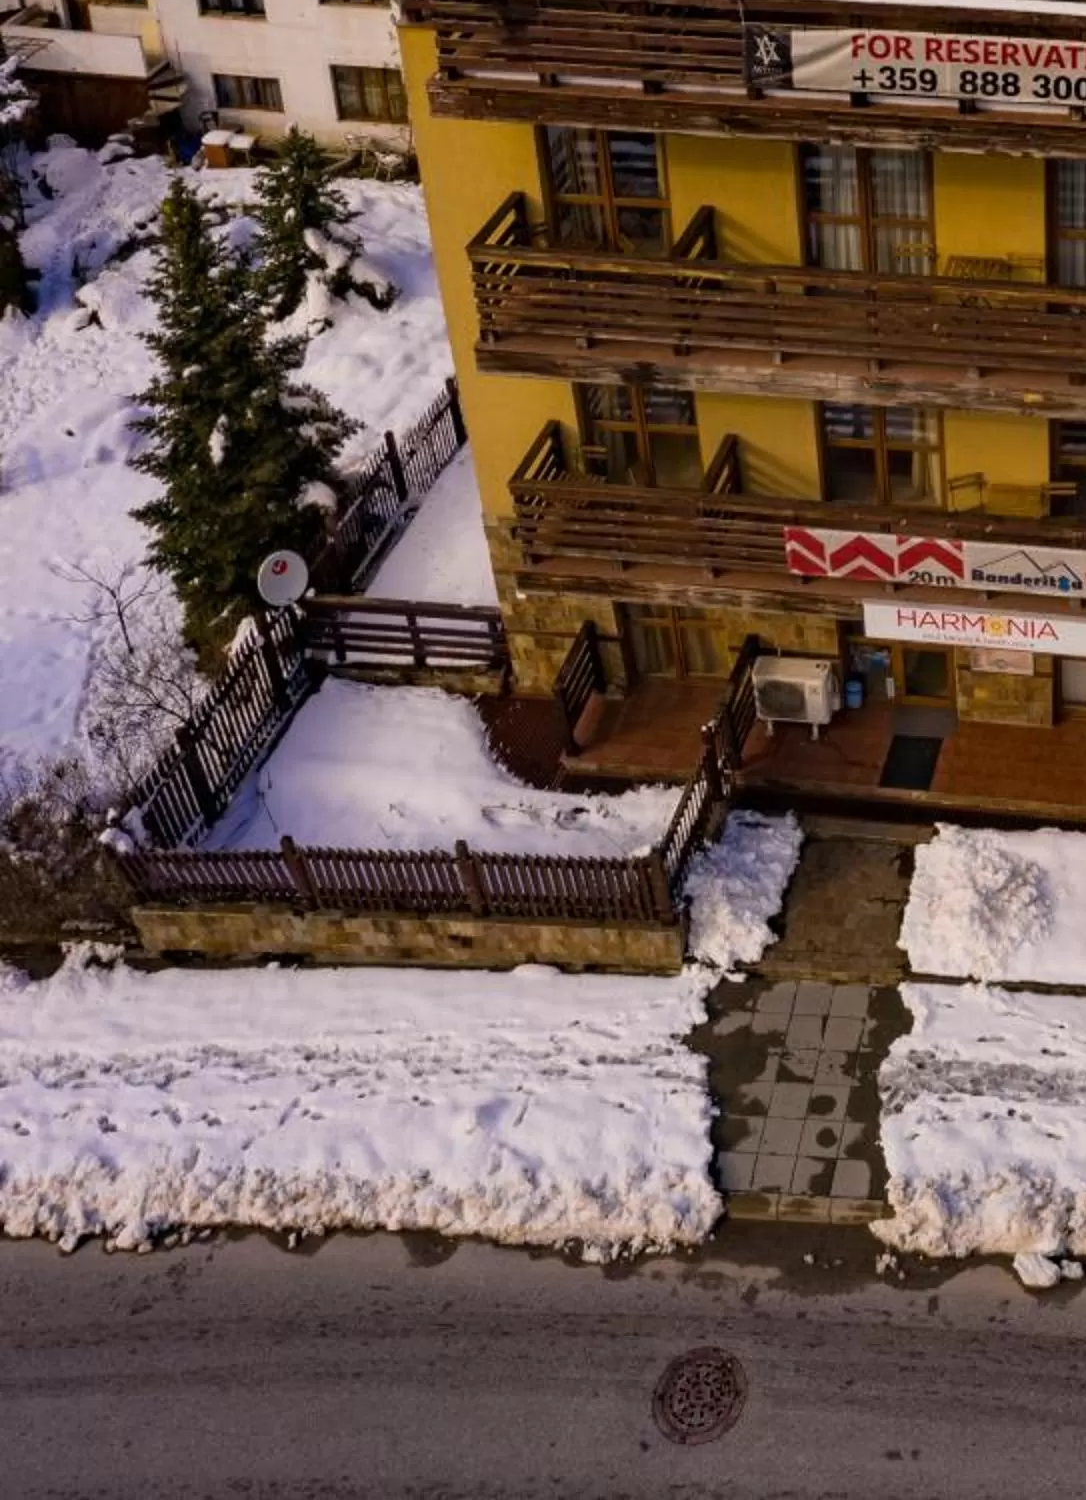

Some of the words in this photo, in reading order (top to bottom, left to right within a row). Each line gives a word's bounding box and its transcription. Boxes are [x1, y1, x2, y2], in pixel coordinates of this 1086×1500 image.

[851, 34, 914, 61] FOR
[852, 66, 938, 93] +359
[959, 70, 1021, 97] 888
[896, 608, 1060, 641] HARMONIA
